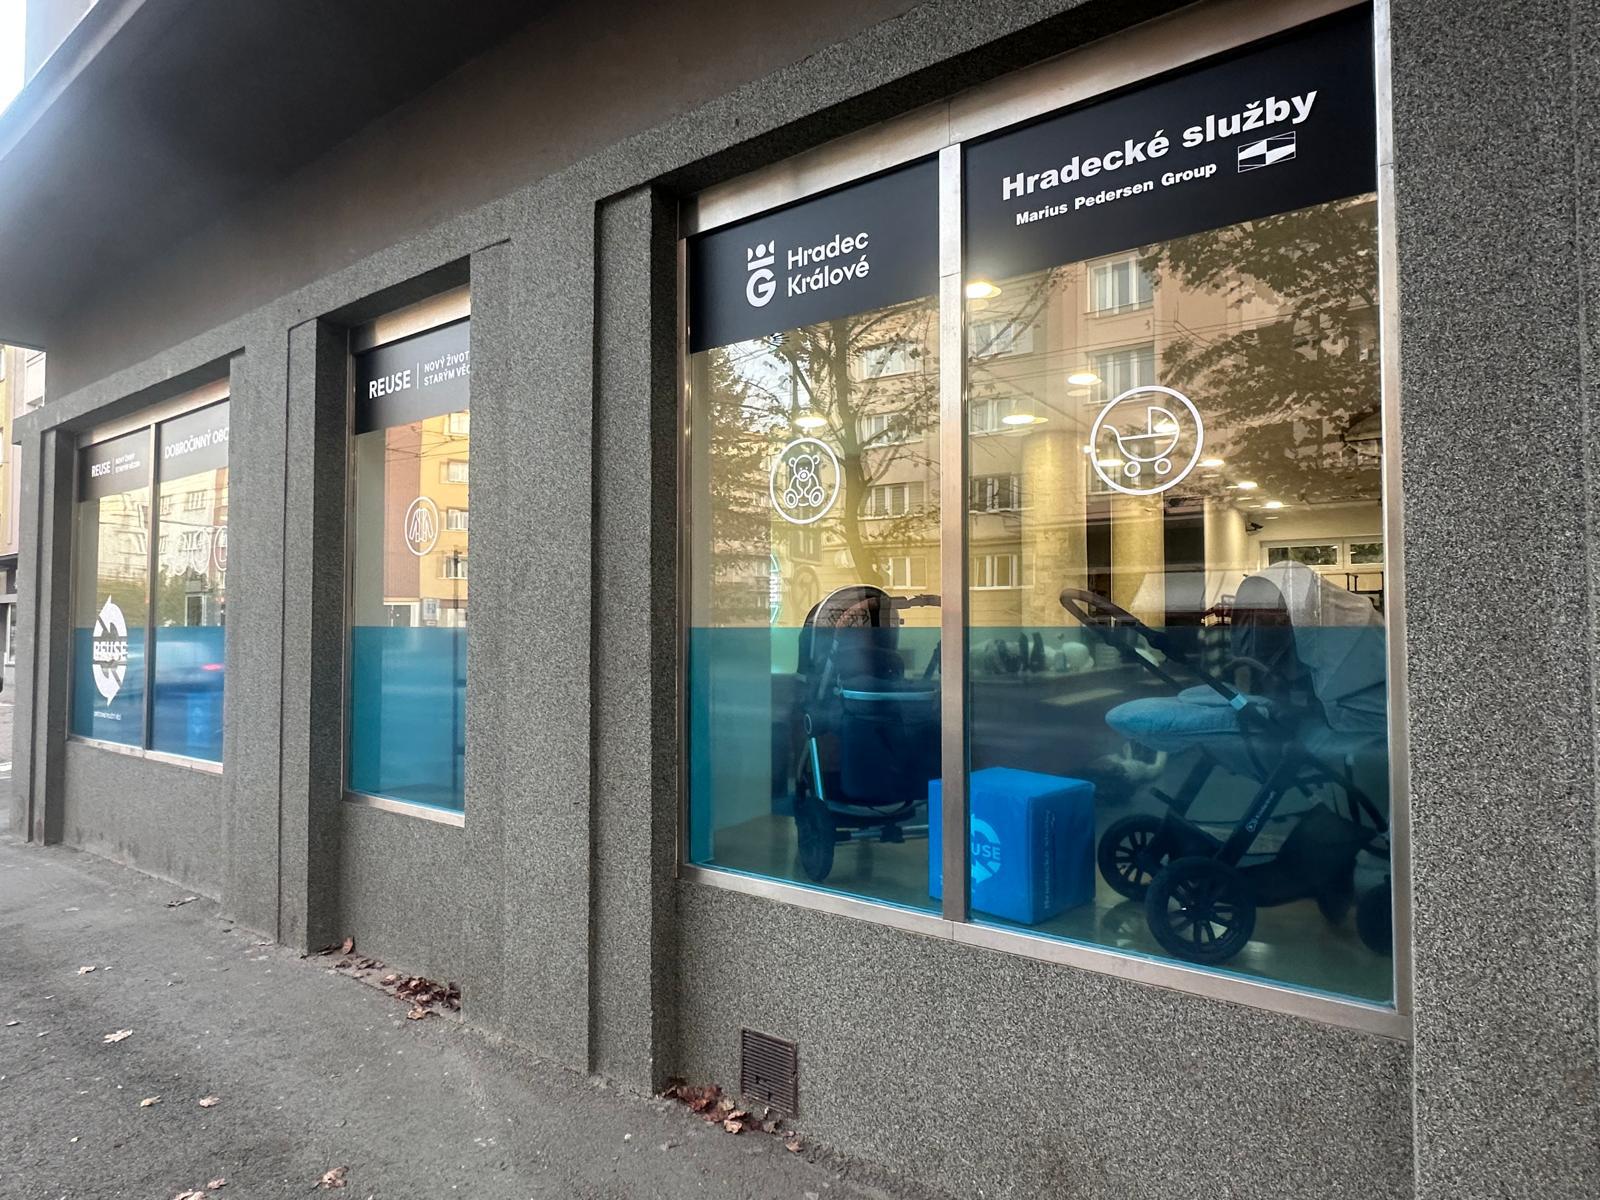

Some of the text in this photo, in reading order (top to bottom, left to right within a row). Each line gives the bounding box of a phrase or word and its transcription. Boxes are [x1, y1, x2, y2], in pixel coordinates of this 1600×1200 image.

[1002, 90, 1318, 201] Hradecké služby
[1015, 162, 1217, 226] Marius Pedersen Group
[787, 232, 869, 270] Hradec
[787, 254, 870, 297] Králové
[424, 350, 470, 373] NOVÝ ŽIVOT
[368, 369, 411, 399] REUSE
[423, 368, 455, 386] STARÝM
[164, 428, 211, 459] DOBROČINNÝ
[91, 461, 111, 478] REUSE
[93, 640, 128, 662] REUSE
